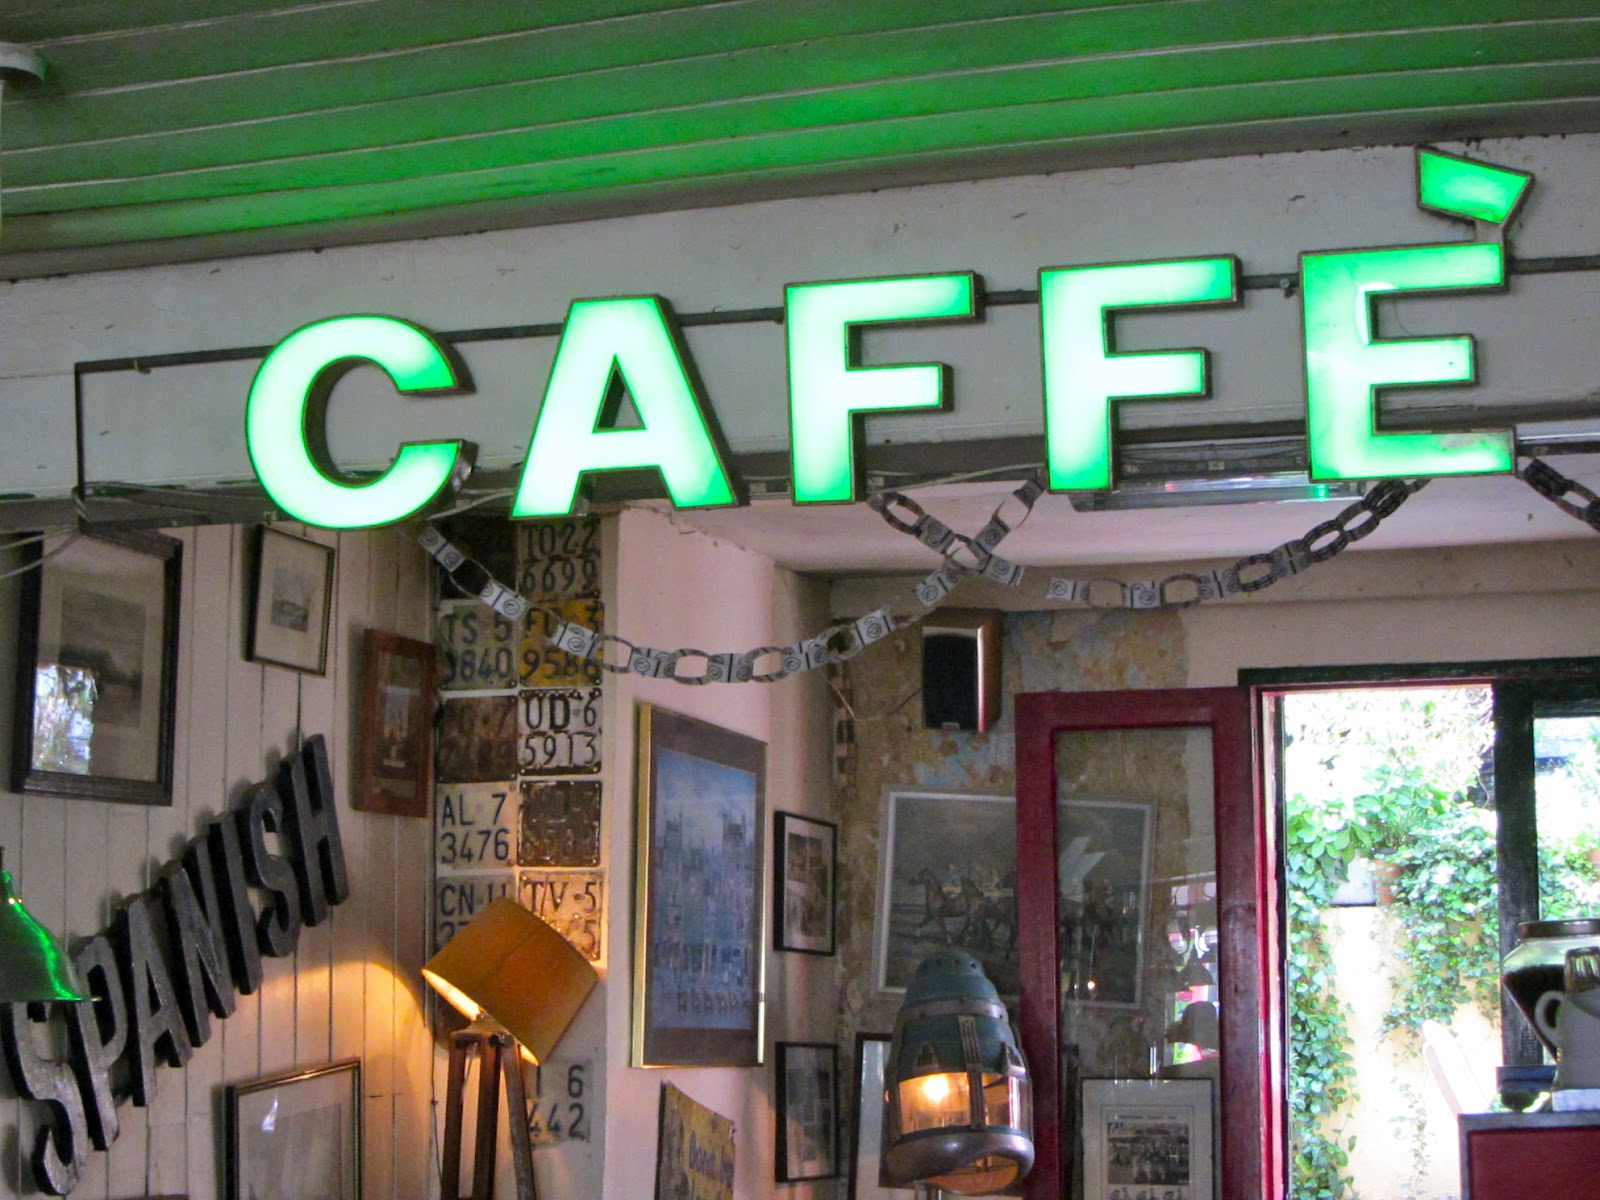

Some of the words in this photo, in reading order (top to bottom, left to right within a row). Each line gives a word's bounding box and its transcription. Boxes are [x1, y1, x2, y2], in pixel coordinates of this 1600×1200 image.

[245, 146, 1536, 530] CAFFÈ
[525, 732, 596, 767] 5913
[441, 794, 475, 828] AL
[491, 792, 508, 826] 7
[440, 828, 510, 864] 3476
[0, 733, 348, 1197] SPANISH
